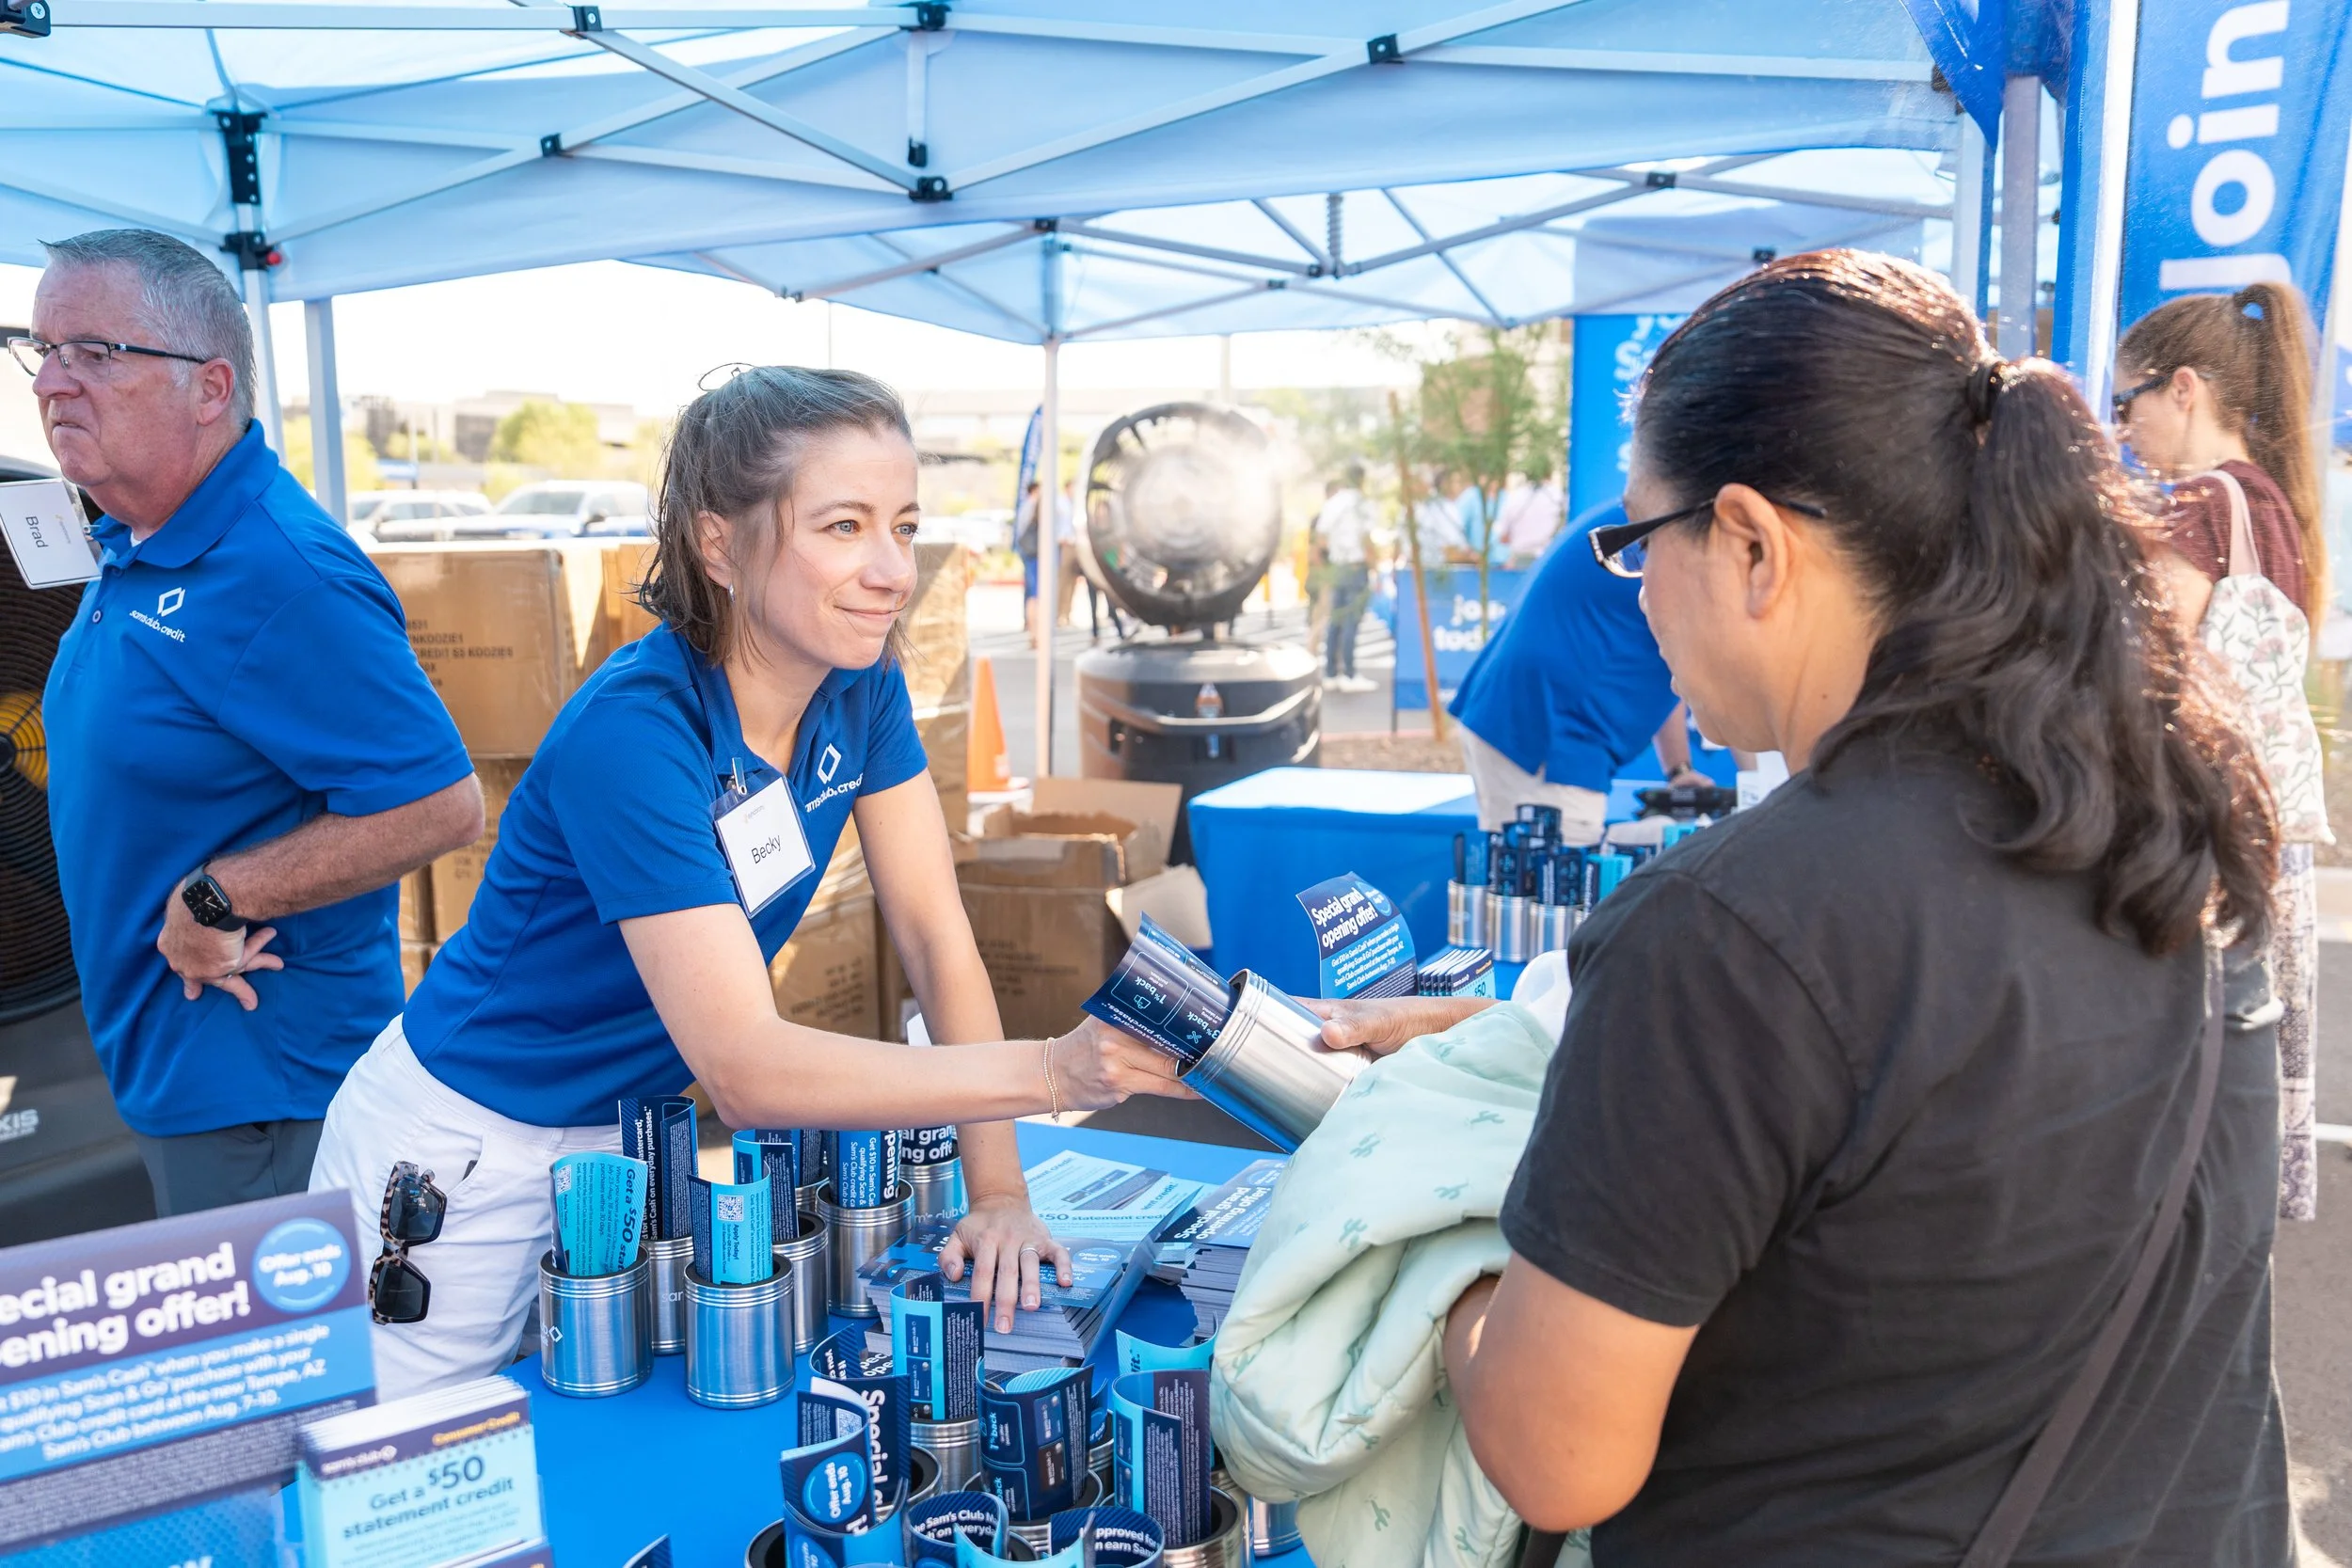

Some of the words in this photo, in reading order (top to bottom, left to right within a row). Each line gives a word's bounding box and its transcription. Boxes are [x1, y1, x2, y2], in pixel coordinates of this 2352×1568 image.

[2160, 1, 2291, 290] Join
[25, 515, 49, 548] Brad
[751, 834, 782, 864] Becky
[1311, 896, 1345, 927] Special
[1340, 887, 1365, 913] grand
[1322, 918, 1359, 949] opening
[1355, 901, 1378, 927] offer!
[1135, 975, 1157, 996] back
[1154, 993, 1168, 1005] 1%
[1186, 1011, 1209, 1030] back
[626, 1167, 634, 1194] Get
[646, 1151, 657, 1187] everyday
[883, 1131, 898, 1199] pening
[626, 1195, 632, 1205] a
[647, 1188, 657, 1197] on
[598, 1212, 604, 1222] 30
[624, 1207, 637, 1244] $50
[1039, 1212, 1069, 1221] $50
[1174, 1210, 1221, 1239] Special
[1216, 1186, 1251, 1211] grand
[1196, 1207, 1247, 1240] opening
[1238, 1186, 1272, 1208] offer!
[259, 1250, 300, 1274] Offer
[300, 1243, 342, 1265] ends
[273, 1264, 314, 1288] Aug.
[312, 1261, 333, 1279] 10
[104, 1242, 236, 1309] grand
[135, 1280, 251, 1338] offer!
[8, 1387, 40, 1411] $10
[40, 1386, 59, 1402] in
[59, 1374, 107, 1399] Sam's
[154, 1355, 200, 1376] when
[200, 1349, 230, 1370] you
[230, 1338, 273, 1358] make
[284, 1324, 330, 1347] single
[83, 1391, 124, 1413] Scan
[124, 1385, 140, 1402] &
[170, 1364, 243, 1392] purchase
[244, 1354, 277, 1373] with
[278, 1347, 312, 1370] your
[36, 1419, 78, 1443] Club
[77, 1407, 126, 1433] credit
[126, 1398, 165, 1419] card
[166, 1395, 182, 1411] at
[183, 1389, 210, 1407] the
[209, 1382, 246, 1400] new
[301, 1358, 326, 1379] AZ
[42, 1435, 90, 1461] Sam's
[90, 1426, 132, 1449] Club
[131, 1410, 203, 1438] between
[990, 1412, 998, 1437] back
[370, 1489, 407, 1511] Get
[414, 1486, 425, 1499] a
[428, 1455, 485, 1490] $50
[824, 1462, 837, 1484] ends
[836, 1465, 848, 1481] 10
[343, 1498, 449, 1539] statement
[456, 1478, 514, 1506] credit
[828, 1486, 840, 1518] Offer
[839, 1480, 852, 1505] Aug.
[926, 1512, 957, 1530] Sam's
[957, 1509, 983, 1521] Club
[1104, 1540, 1132, 1553] earn
